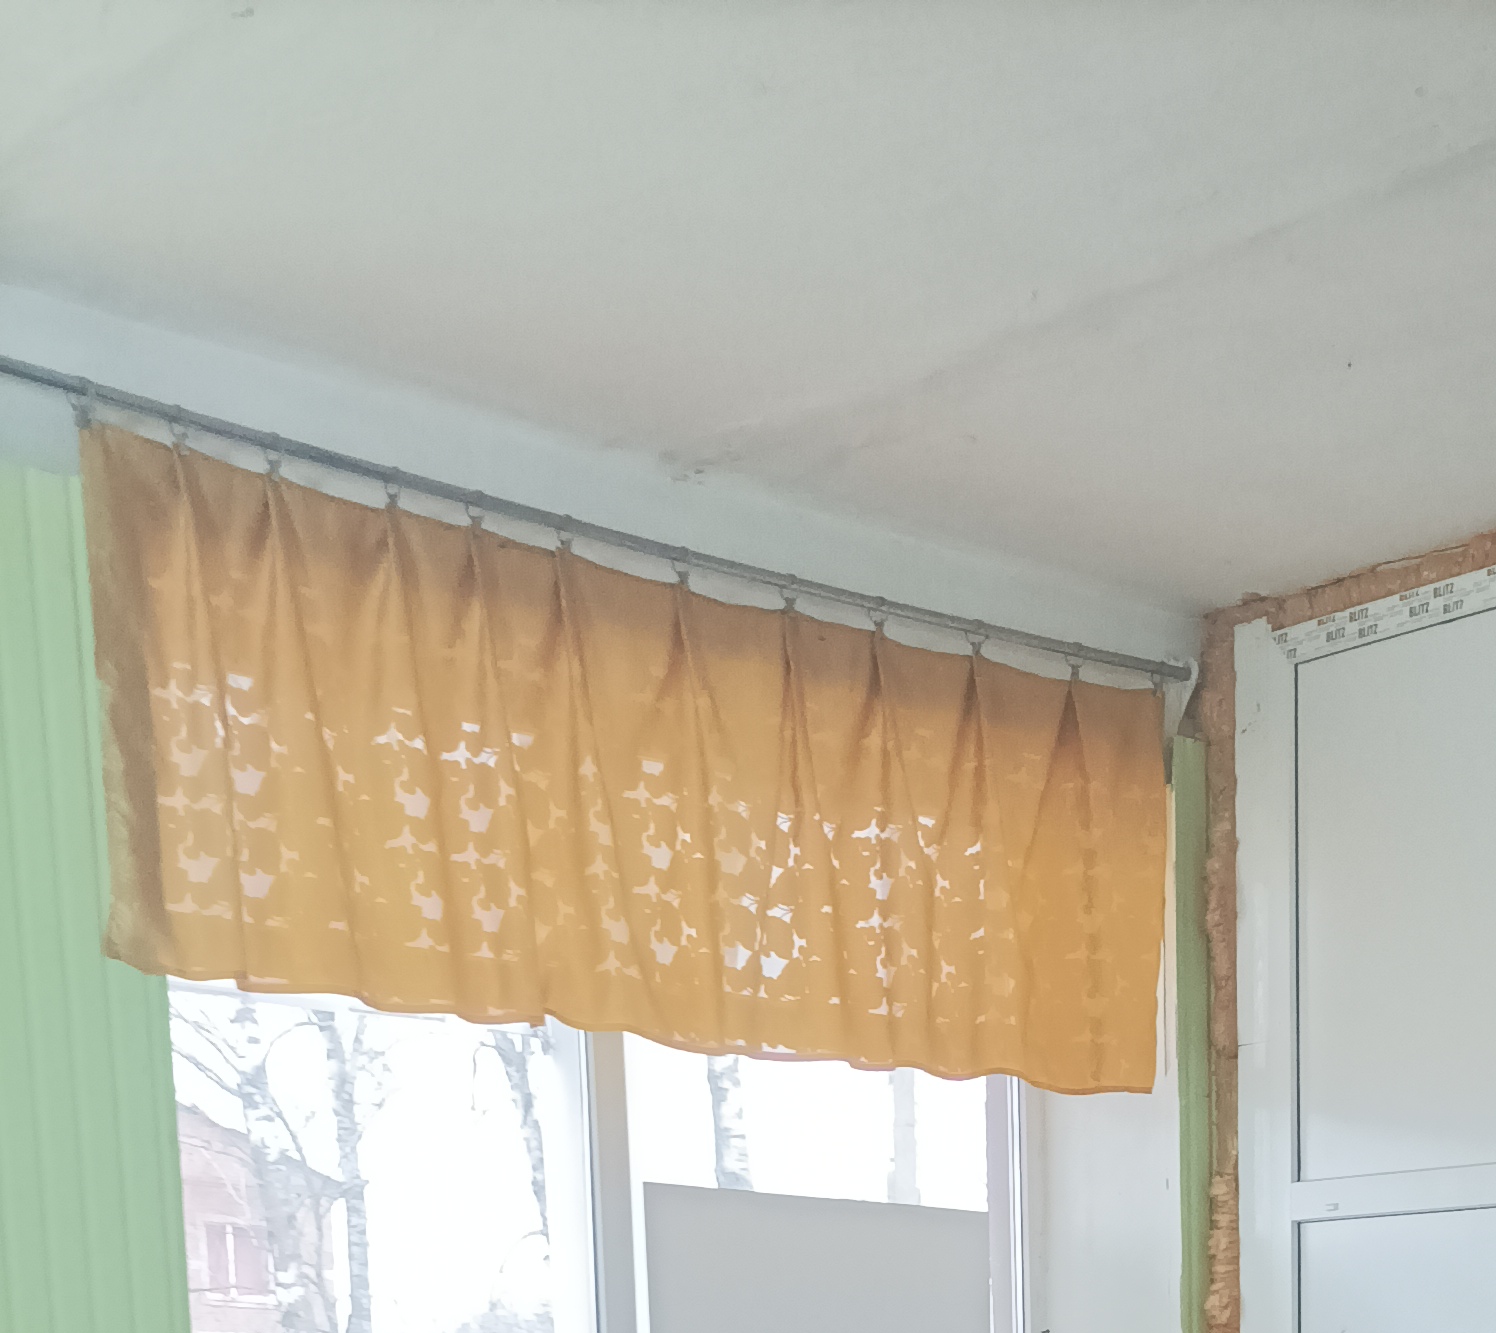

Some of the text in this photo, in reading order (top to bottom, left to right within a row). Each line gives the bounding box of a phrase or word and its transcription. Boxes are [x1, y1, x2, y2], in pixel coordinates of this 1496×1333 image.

[1326, 627, 1346, 643] BLITZ
[1358, 624, 1379, 639] BLITZ
[1409, 602, 1430, 618] BLITZ
[1442, 599, 1464, 615] BLITZ
[1349, 607, 1369, 623] BLITZ
[1433, 582, 1455, 599] BLITZ
